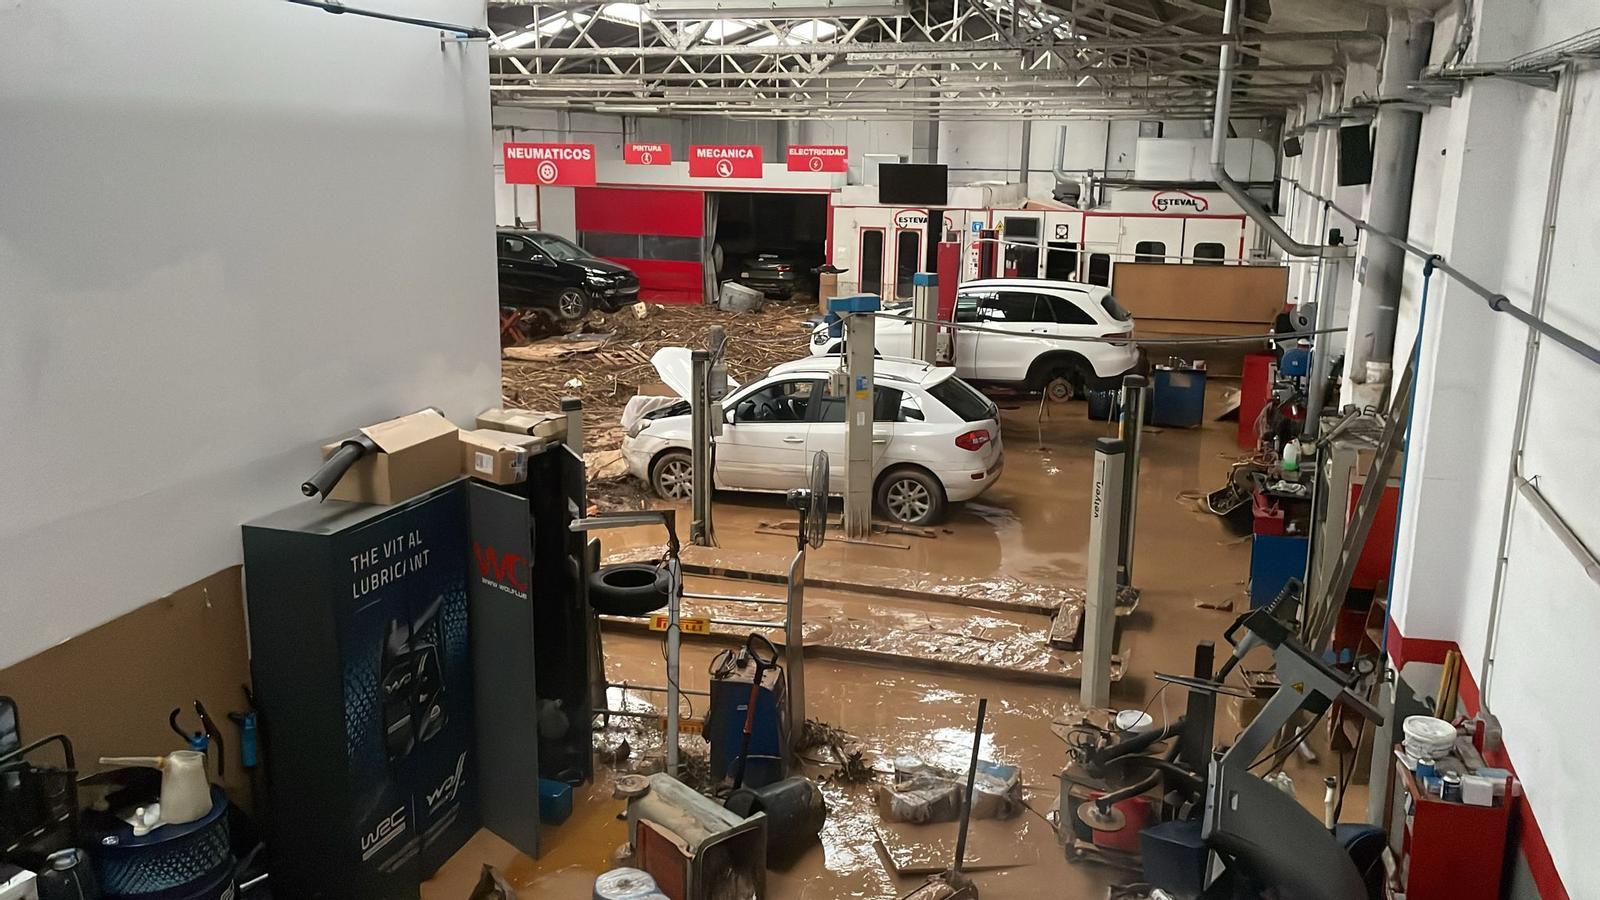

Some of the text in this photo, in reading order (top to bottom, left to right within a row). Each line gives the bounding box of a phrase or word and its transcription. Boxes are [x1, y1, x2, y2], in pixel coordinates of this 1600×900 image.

[507, 147, 591, 161] NEUMATICOS
[632, 145, 662, 153] PINTURA
[696, 148, 754, 159] MECANICA
[788, 148, 846, 157] ELECTRICIDAD
[1157, 198, 1197, 206] ESTEVAL
[898, 216, 930, 224] ESTEVA
[350, 547, 379, 574] THE
[361, 806, 406, 850] WRC
